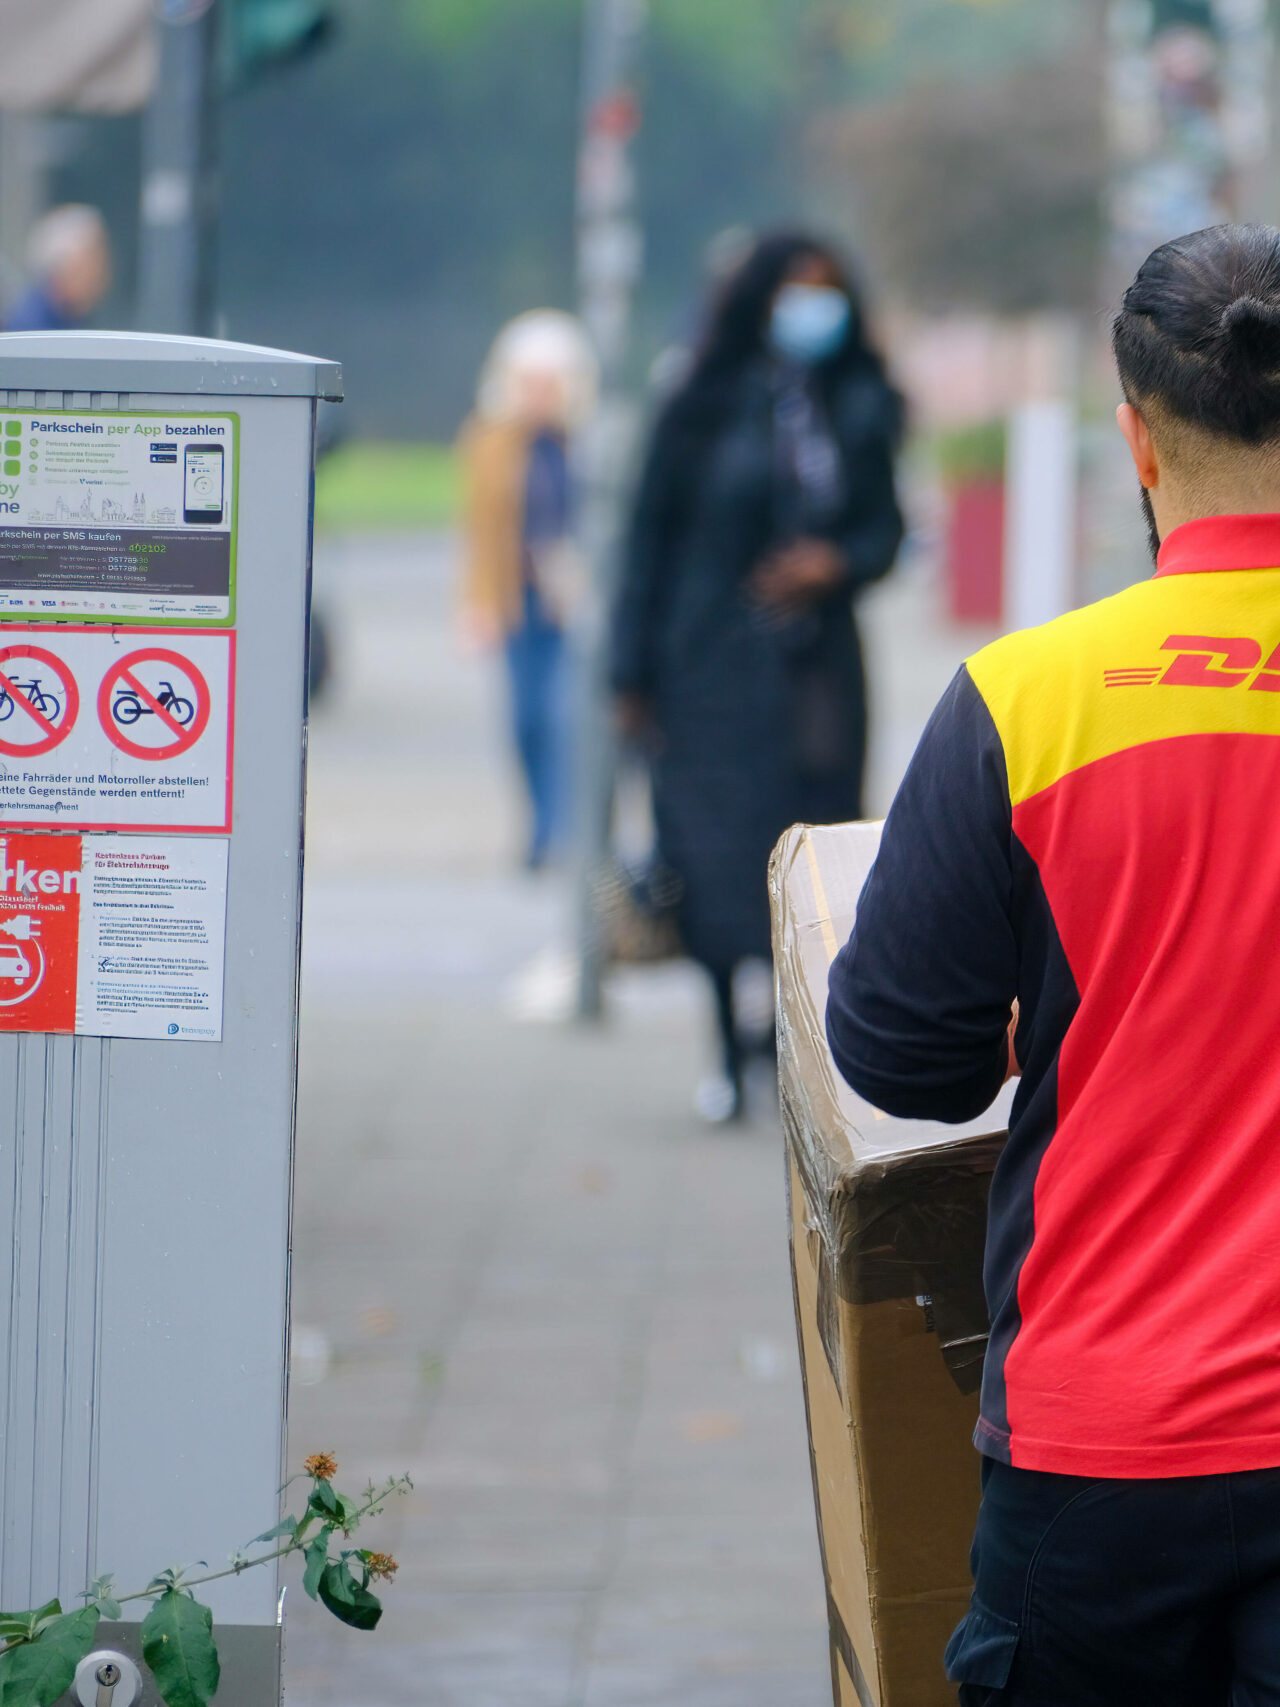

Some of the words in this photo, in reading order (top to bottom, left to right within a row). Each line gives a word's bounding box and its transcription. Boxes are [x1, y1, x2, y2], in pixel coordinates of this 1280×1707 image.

[31, 421, 104, 434] Parkschein
[107, 425, 130, 435] per
[133, 424, 161, 437] App
[165, 425, 225, 436] bezahlen
[0, 530, 41, 540] rkschein
[44, 532, 60, 541] per
[63, 532, 86, 541] SMS
[89, 533, 121, 542] kaufen
[129, 543, 167, 554] 402102
[23, 773, 73, 784] Fahrräder
[75, 775, 95, 784] und
[98, 774, 156, 785] Motorroller
[158, 776, 209, 786] abstellen!
[29, 786, 96, 798] Gegenstände
[100, 788, 137, 798] werden
[140, 789, 185, 799] entfernt!
